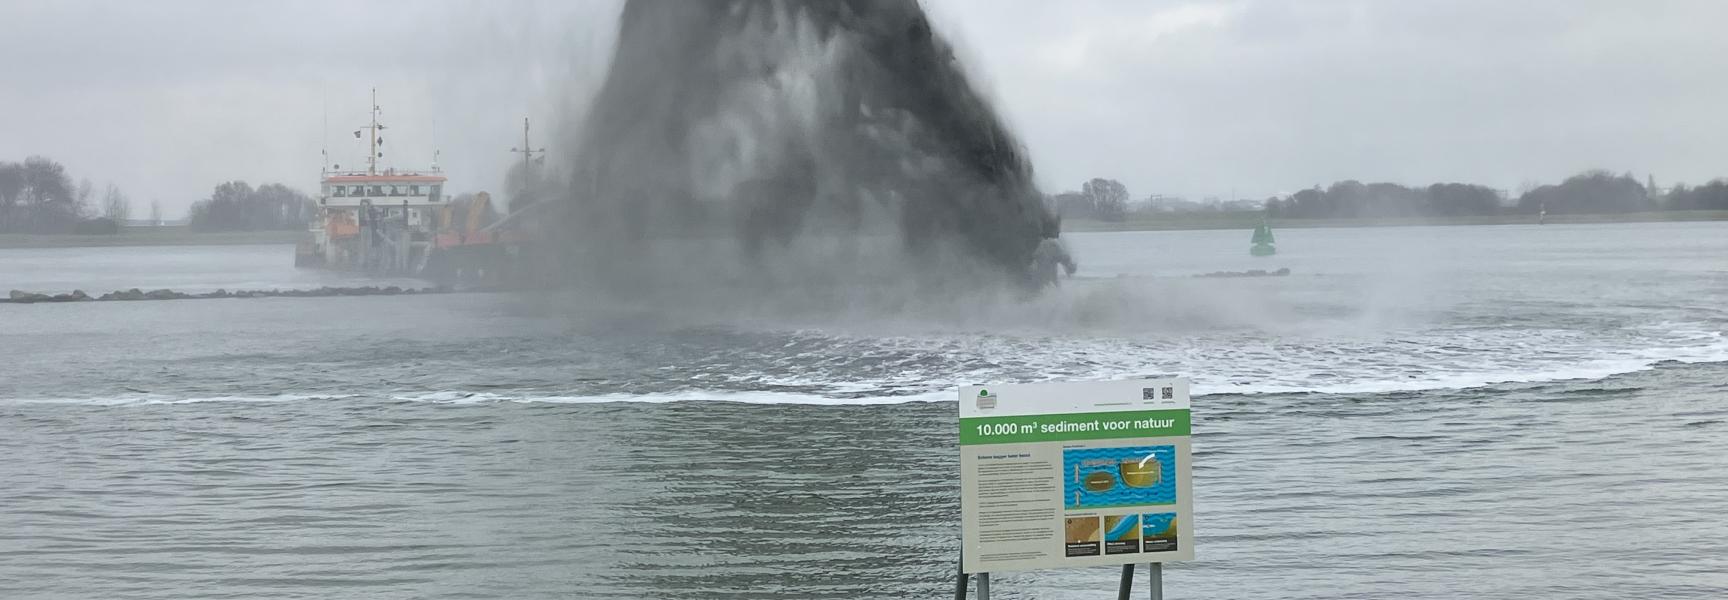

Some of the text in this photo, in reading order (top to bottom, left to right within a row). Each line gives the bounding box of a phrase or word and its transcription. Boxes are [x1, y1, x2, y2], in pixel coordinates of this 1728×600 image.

[976, 423, 1018, 436] 10.000
[1041, 419, 1100, 433] sediment
[1102, 421, 1131, 431] voor
[1134, 418, 1175, 429] natuur
